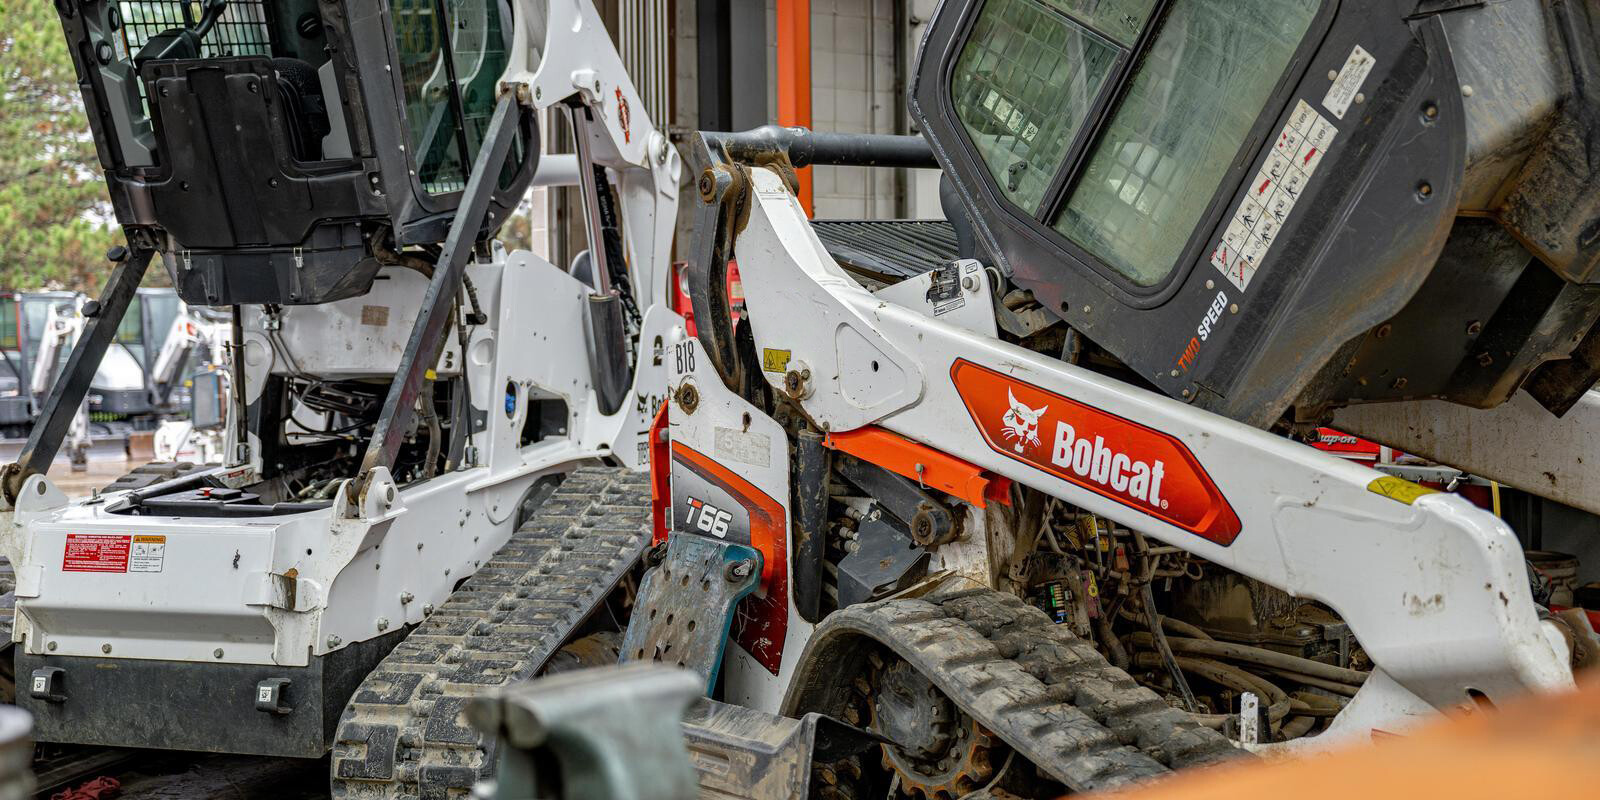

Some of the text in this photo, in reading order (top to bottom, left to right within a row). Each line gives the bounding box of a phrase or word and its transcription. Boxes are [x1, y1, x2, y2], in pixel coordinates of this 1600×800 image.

[1177, 291, 1228, 369] TWO SPEED
[675, 340, 696, 375] B18
[1319, 434, 1358, 446] nap-on
[1051, 420, 1165, 507] Bobcat
[686, 496, 733, 539] T66
